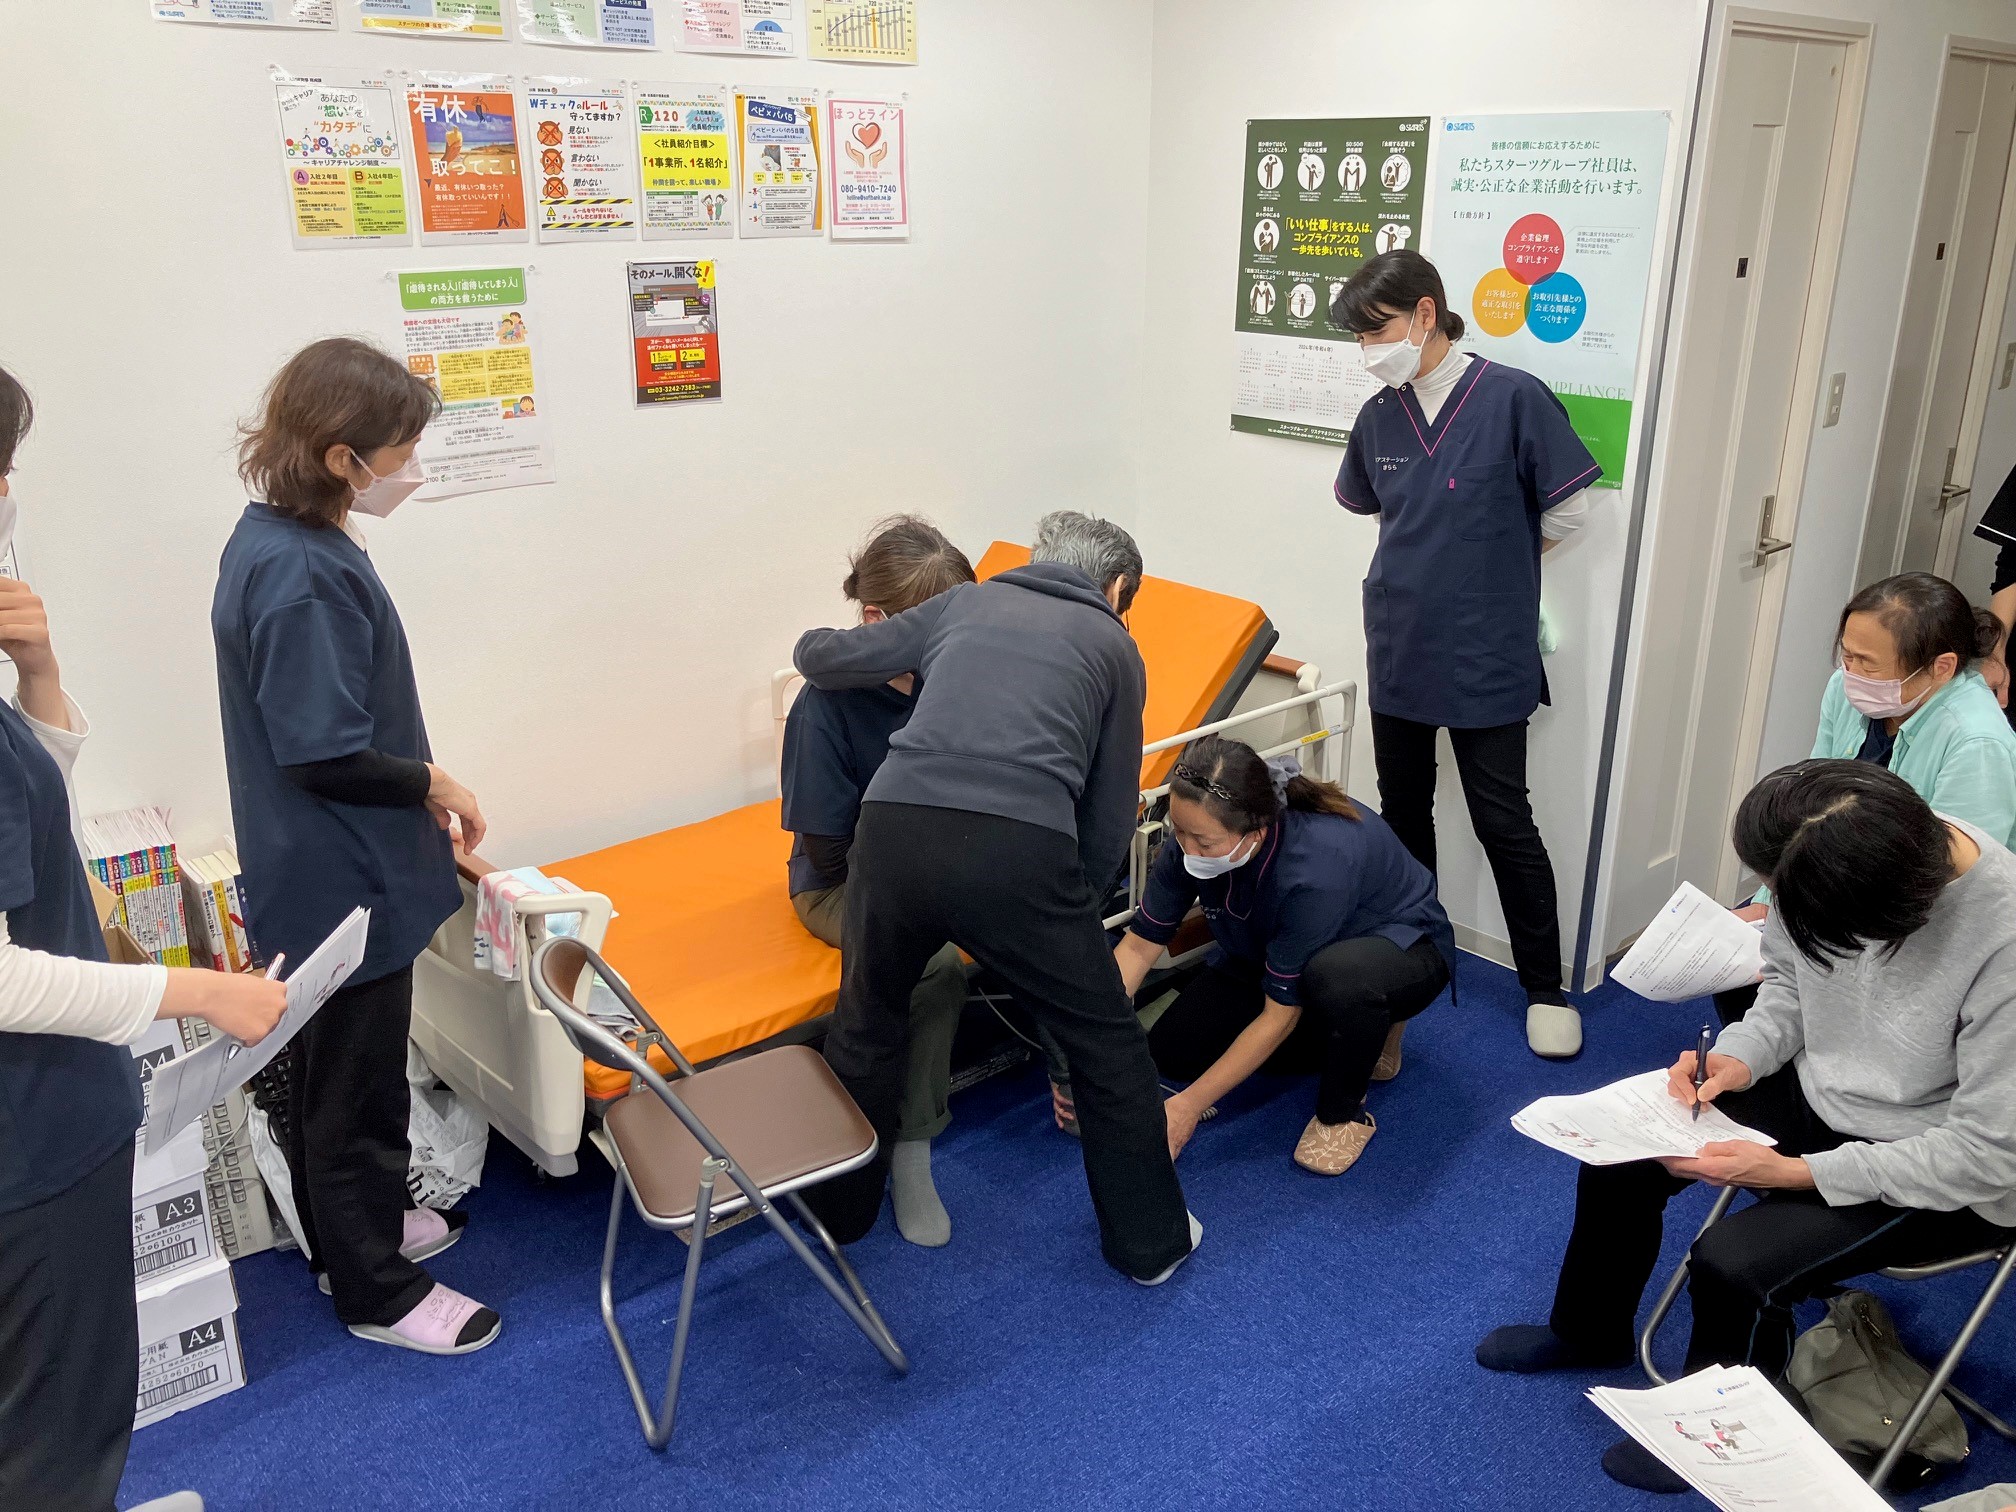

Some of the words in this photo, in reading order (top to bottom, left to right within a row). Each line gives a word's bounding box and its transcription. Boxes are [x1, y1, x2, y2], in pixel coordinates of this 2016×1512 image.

[320, 93, 358, 103] あなたの
[413, 94, 467, 123] 有休
[529, 98, 609, 111] Wチェックのルール
[569, 111, 621, 121] 守ってますか？
[640, 108, 648, 121] R
[654, 110, 679, 122] 120
[834, 107, 899, 121] ほっとライン
[568, 126, 590, 134] 見ない
[1491, 140, 1600, 151] 皆様の信頼にお応えするために
[571, 153, 600, 162] 言わない
[431, 158, 516, 177] 取ってこ！
[1459, 157, 1638, 173] 私たちスターツグループ社員は、
[297, 171, 305, 180] A
[354, 171, 364, 181] B
[573, 178, 602, 187] 聞かない
[1450, 178, 1643, 195] 誠実・公正な企業活動を行います。
[841, 184, 897, 193] 080-9410-7240
[1285, 217, 1373, 234] 「いい仕事」をする人は、
[1293, 233, 1359, 244] コンプライアンスの
[1520, 233, 1550, 243] 企業倫理
[1291, 244, 1363, 258] 一歩先を歩いている。
[1508, 244, 1560, 254] コンプライアンスを
[1516, 255, 1549, 264] 遵守します
[1486, 290, 1518, 299] お客様との
[1533, 293, 1582, 303] お取引先様との
[1482, 300, 1522, 310] 適正な取引を
[1535, 304, 1577, 314] 公正な関係を
[1485, 312, 1515, 320] いたします
[1540, 316, 1569, 324] つくります
[165, 1197, 195, 1221] A3
[188, 1324, 217, 1349] A4
